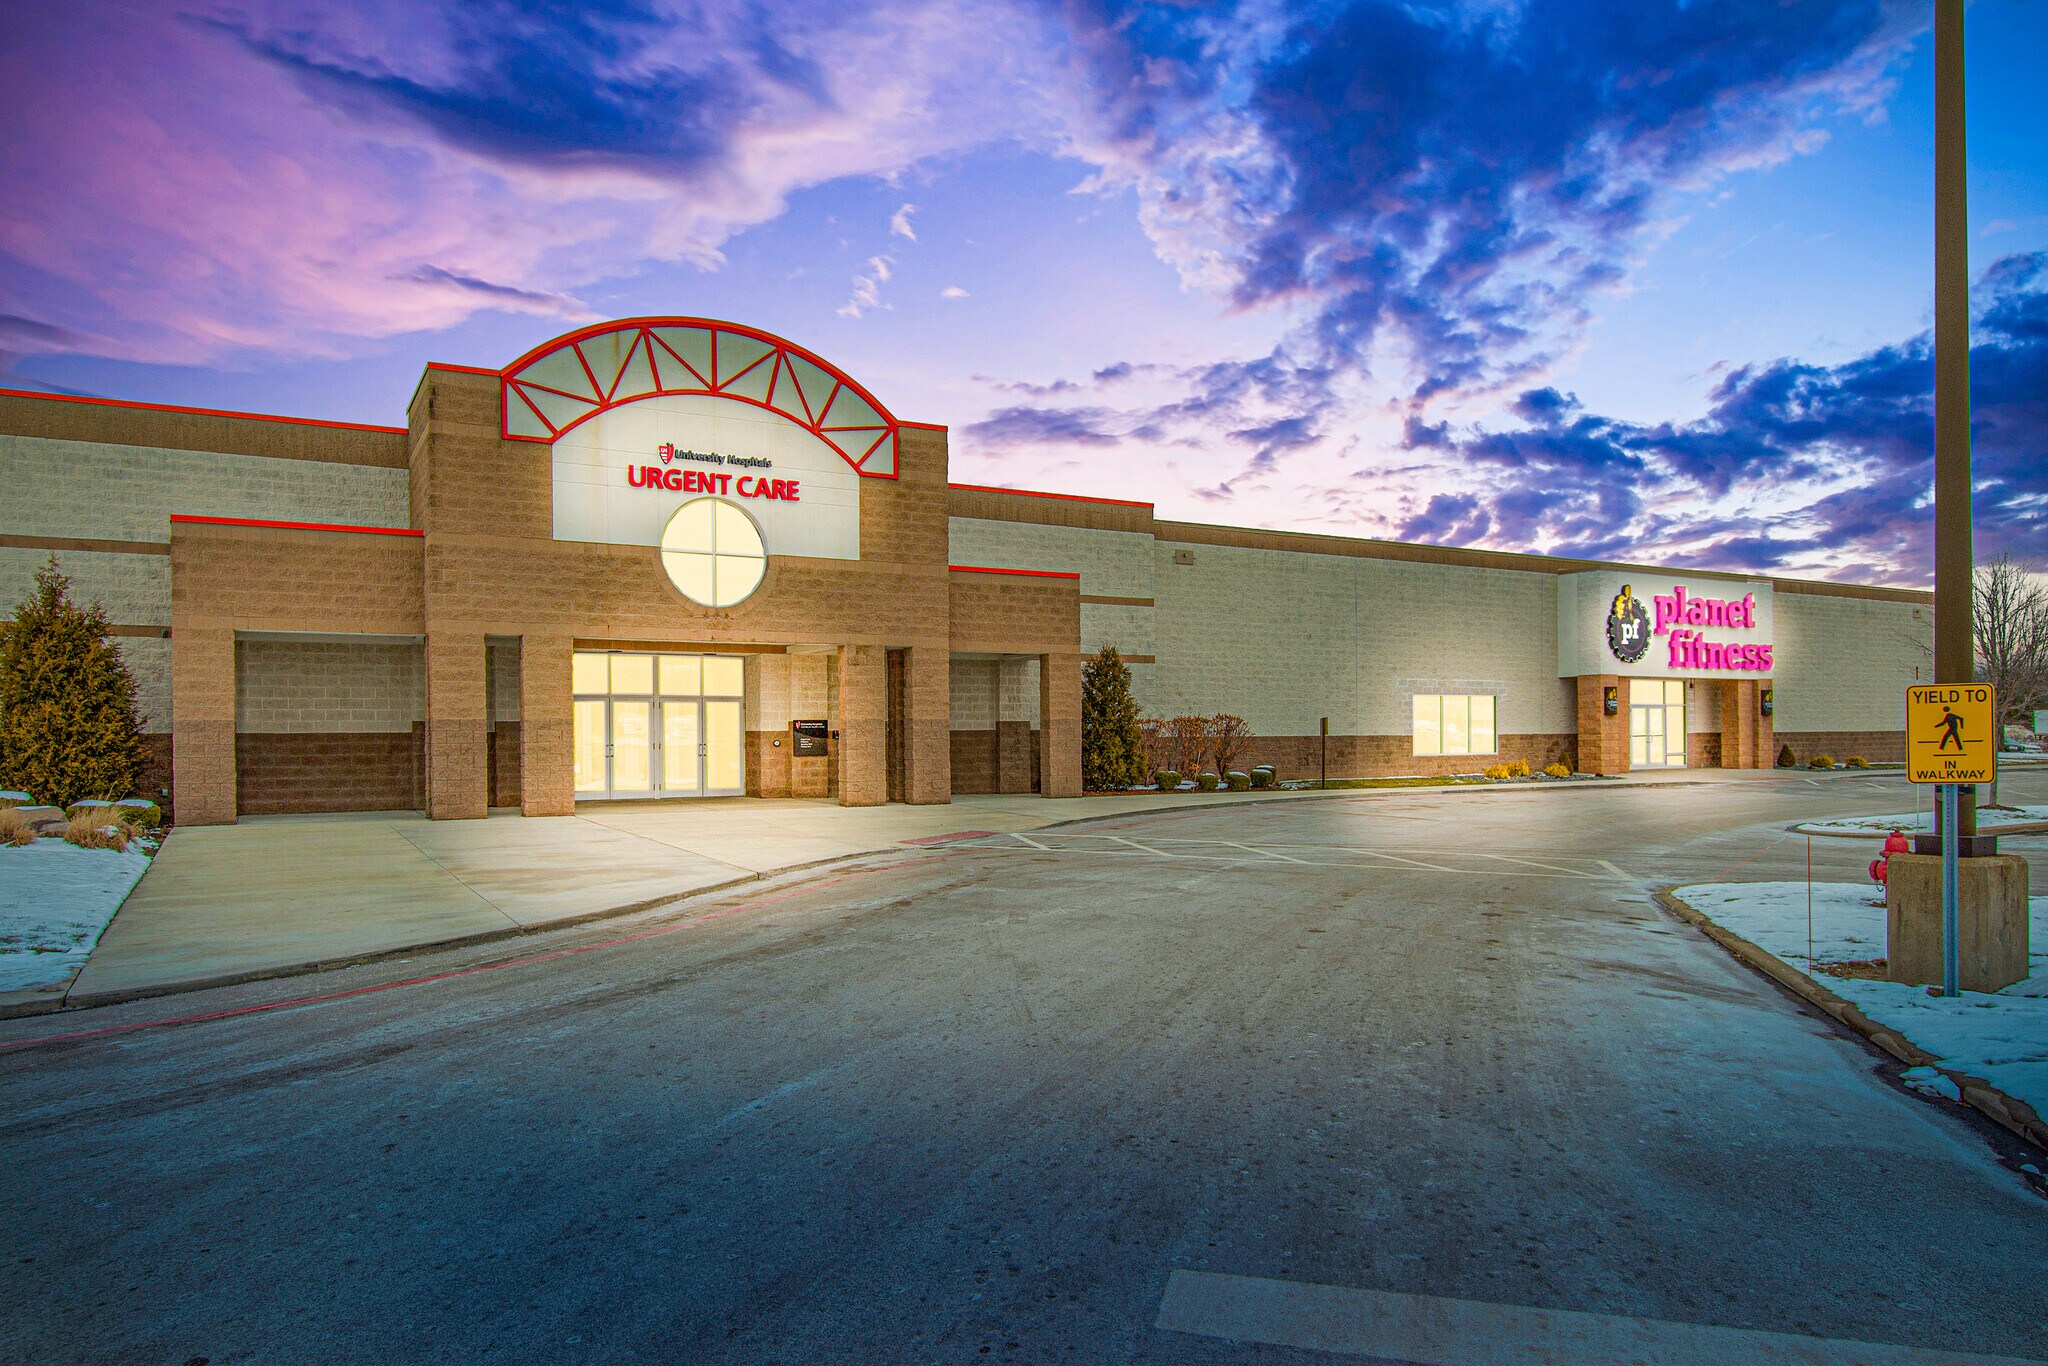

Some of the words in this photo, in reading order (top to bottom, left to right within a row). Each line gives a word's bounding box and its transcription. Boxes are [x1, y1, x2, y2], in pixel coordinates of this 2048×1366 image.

[674, 449, 725, 465] University
[727, 454, 772, 468] Hospitals
[627, 464, 733, 495] URGENT
[736, 475, 800, 501] CARE
[1654, 586, 1755, 635] planet
[1621, 618, 1641, 645] pf
[1668, 628, 1774, 672] fitness
[1913, 690, 1960, 704] YIELD
[1965, 689, 1987, 703] TO
[1916, 769, 1986, 779] WALKWAY
[1944, 760, 1957, 769] IN
